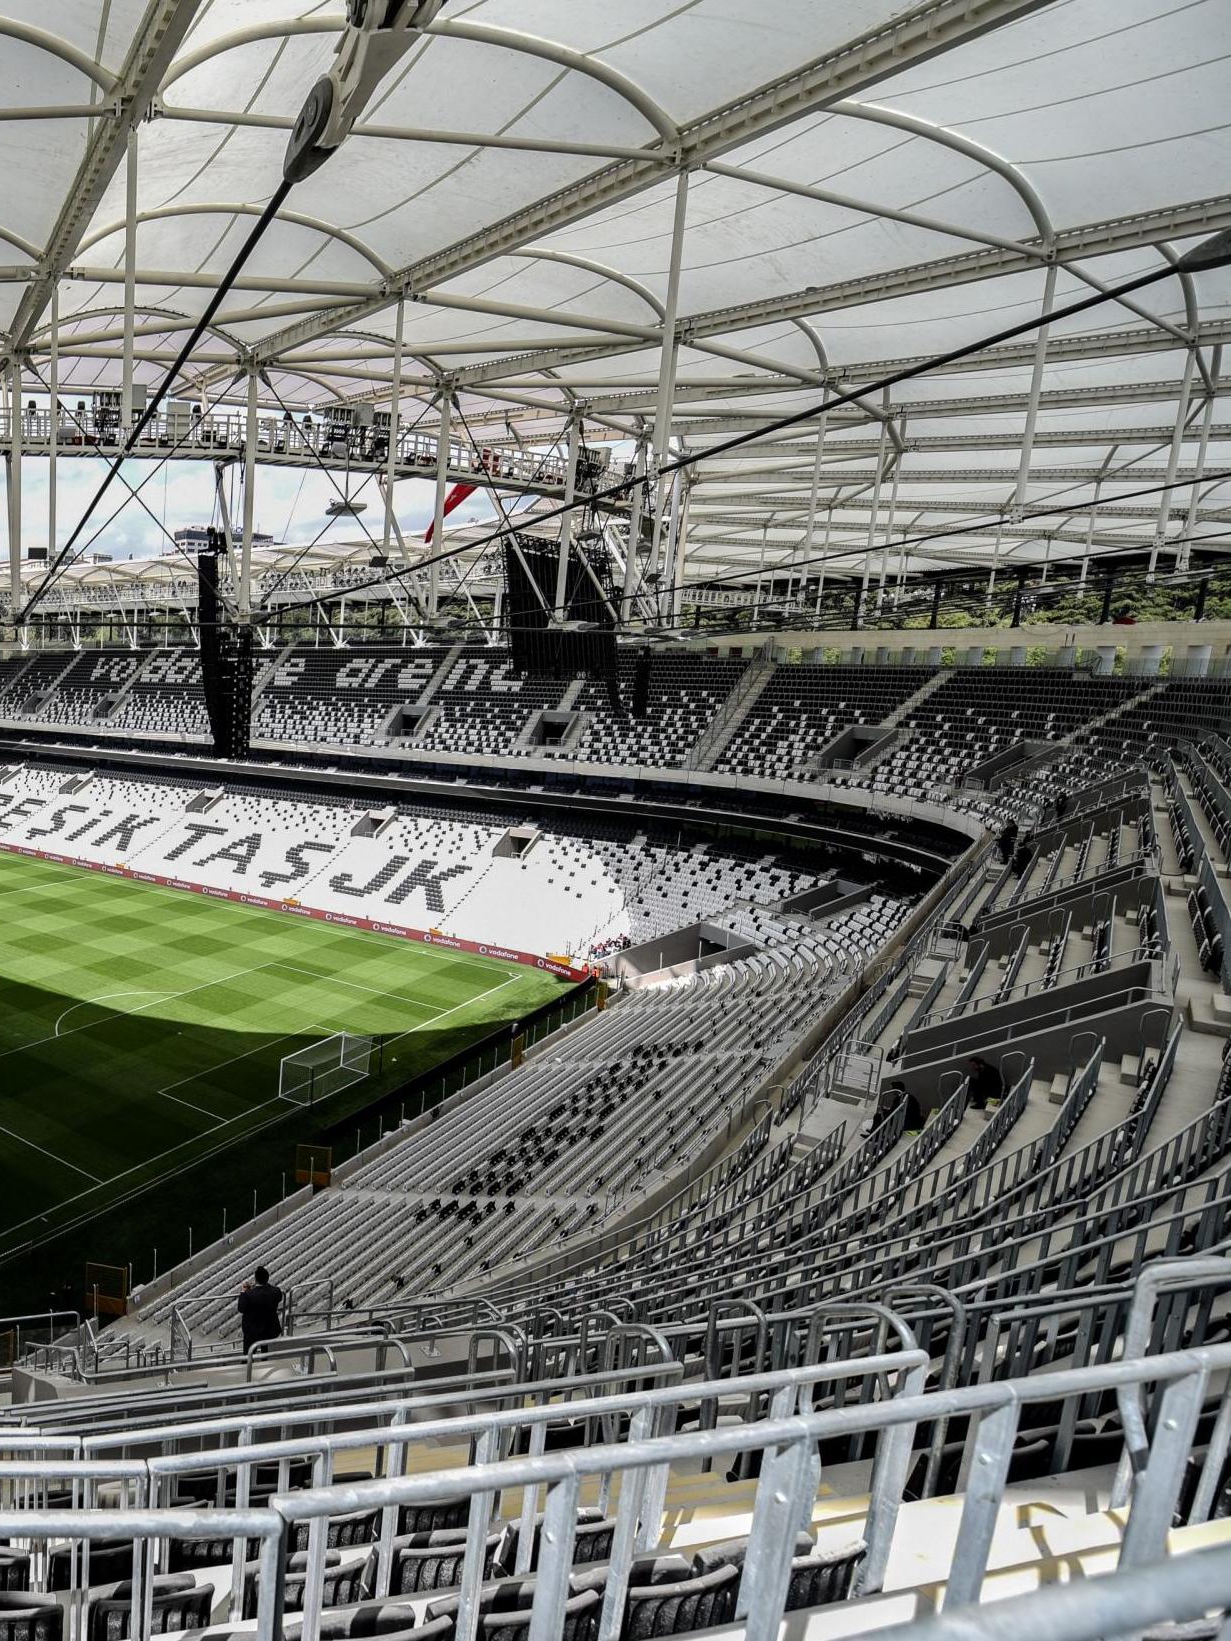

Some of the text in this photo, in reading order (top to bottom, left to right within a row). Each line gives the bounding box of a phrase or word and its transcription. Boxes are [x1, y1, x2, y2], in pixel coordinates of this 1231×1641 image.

[329, 855, 473, 913] JK
[247, 897, 268, 906] vodafone
[288, 906, 311, 915] vodafone
[333, 915, 357, 925] vodafone
[381, 925, 407, 936] vodafone
[432, 936, 461, 948] vodafone
[488, 948, 519, 960] vodafone
[545, 962, 571, 977] vodafone
